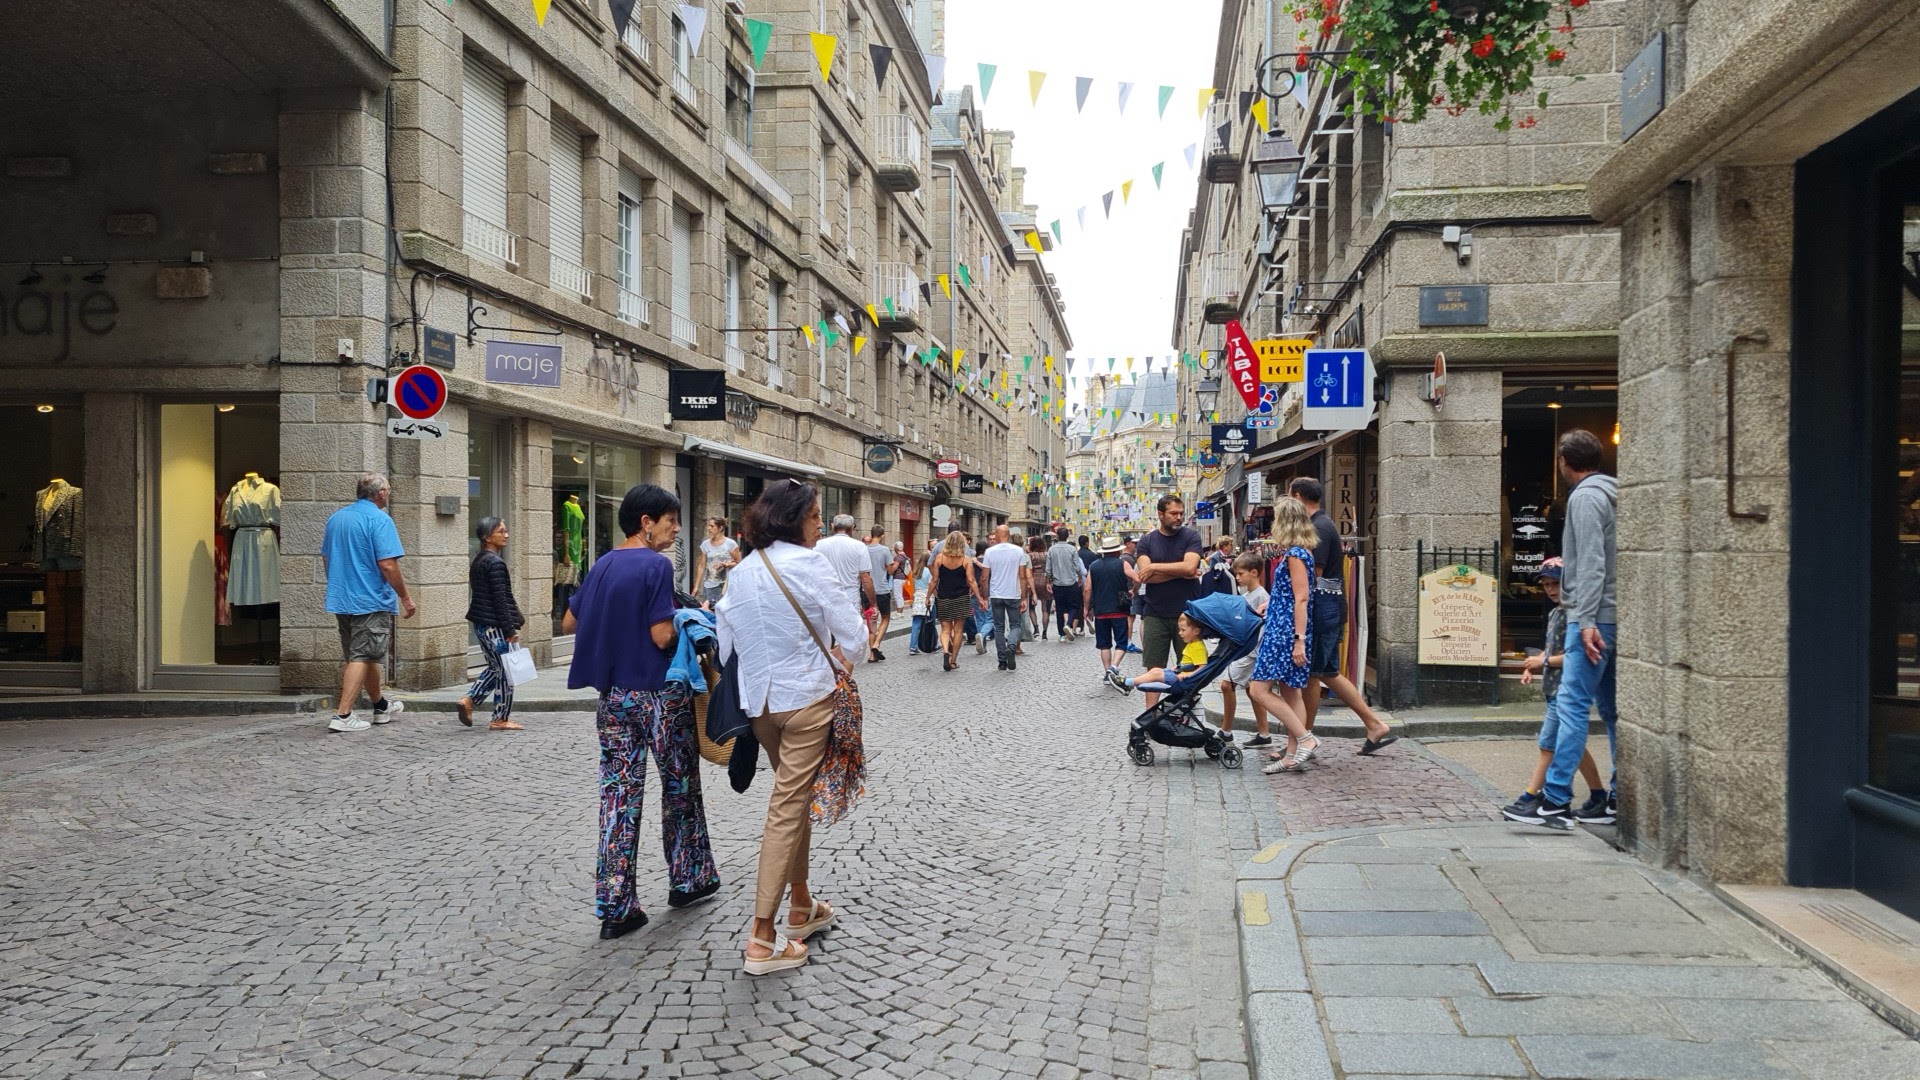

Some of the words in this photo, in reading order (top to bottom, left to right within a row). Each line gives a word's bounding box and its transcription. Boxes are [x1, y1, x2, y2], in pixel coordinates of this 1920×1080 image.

[0, 274, 119, 362] aje
[495, 353, 554, 380] maje
[1231, 337, 1255, 393] TABAC
[1268, 366, 1303, 375] LOTO
[680, 396, 718, 405] IKKS
[1515, 553, 1544, 562] bugatti
[1432, 594, 1447, 605] RUE
[1462, 593, 1485, 606] HARPE
[1441, 603, 1473, 611] Crêperie
[1432, 625, 1449, 637] PLACE
[1441, 647, 1471, 656] Opticien
